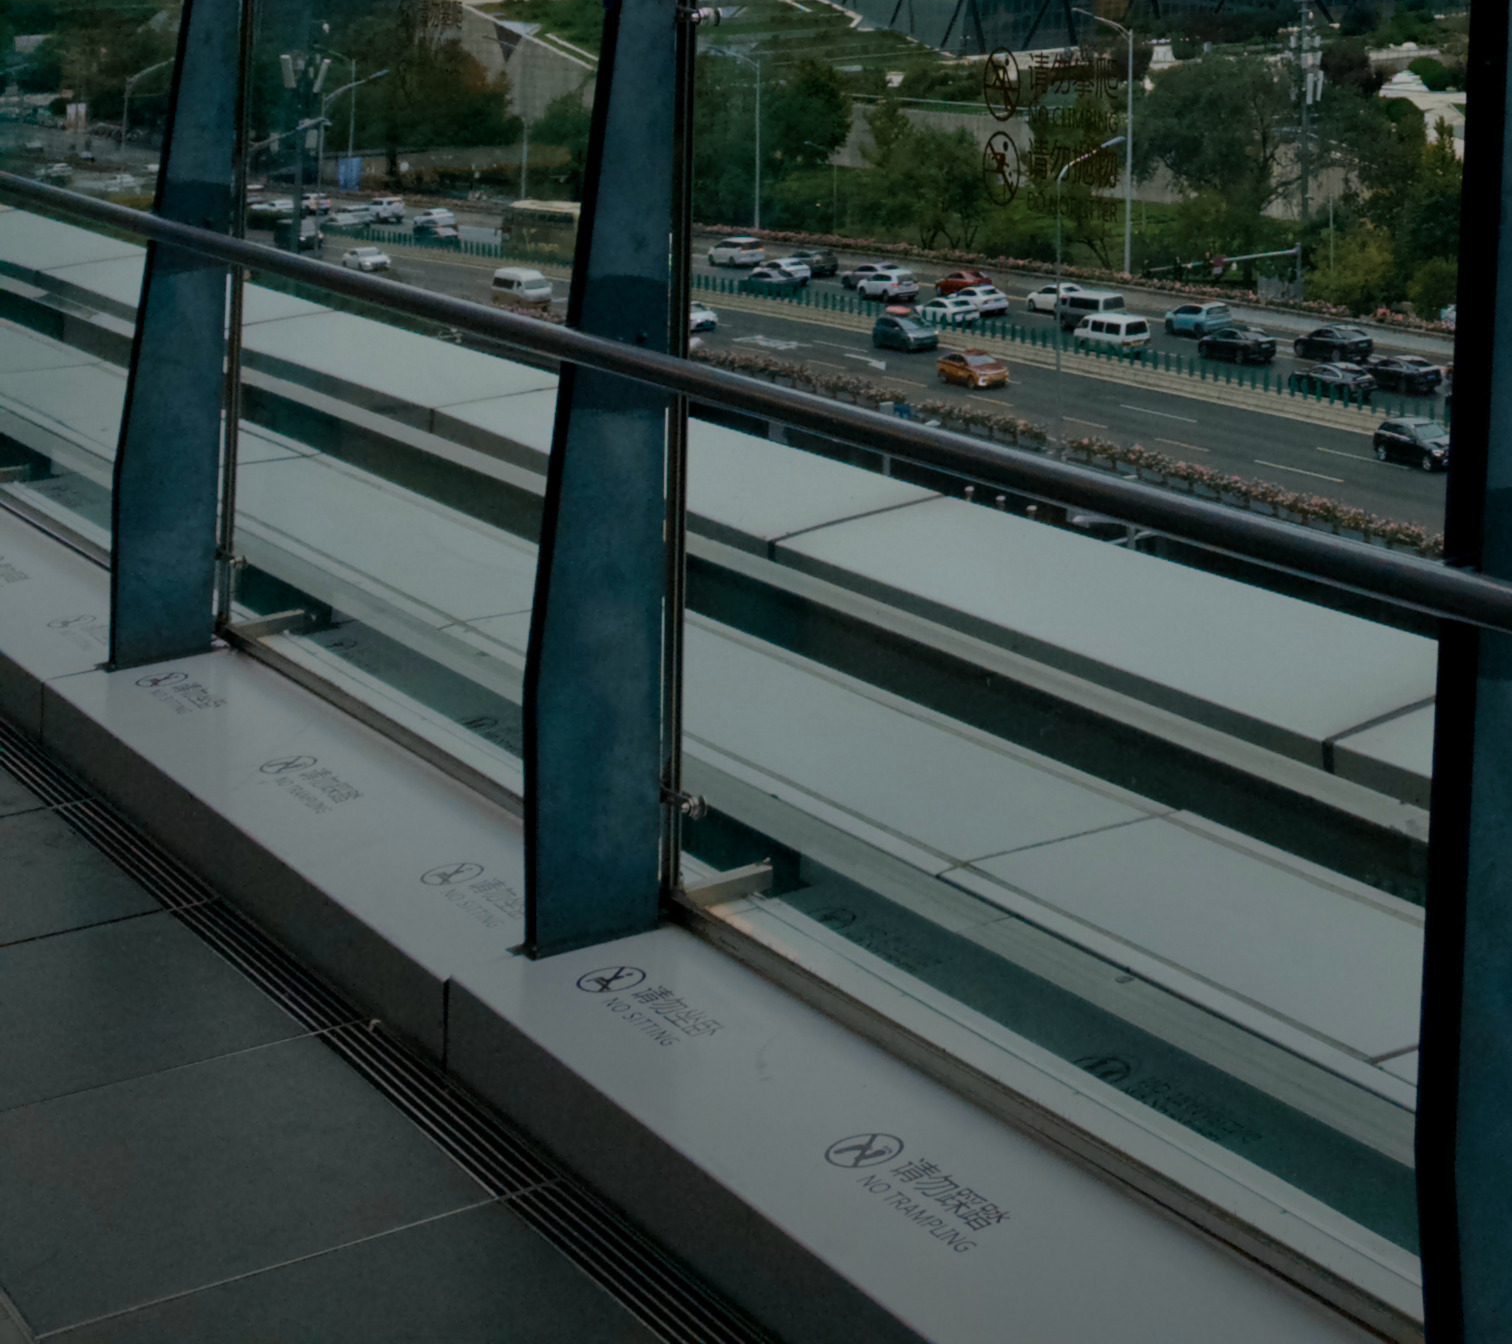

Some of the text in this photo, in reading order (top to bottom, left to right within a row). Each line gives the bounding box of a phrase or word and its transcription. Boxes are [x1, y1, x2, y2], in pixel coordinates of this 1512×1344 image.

[1029, 46, 1118, 99] 请勿攀爬
[1029, 104, 1118, 133] NO CLIMBING
[1028, 137, 1118, 188] 请勿抛物
[1077, 198, 1118, 223] ITTER
[602, 996, 681, 1047] NO SITTING
[631, 984, 725, 1038] 请勿坐卧
[856, 1174, 978, 1254] NO TRAMPLING
[890, 1157, 1012, 1232] 请勿踩踏
